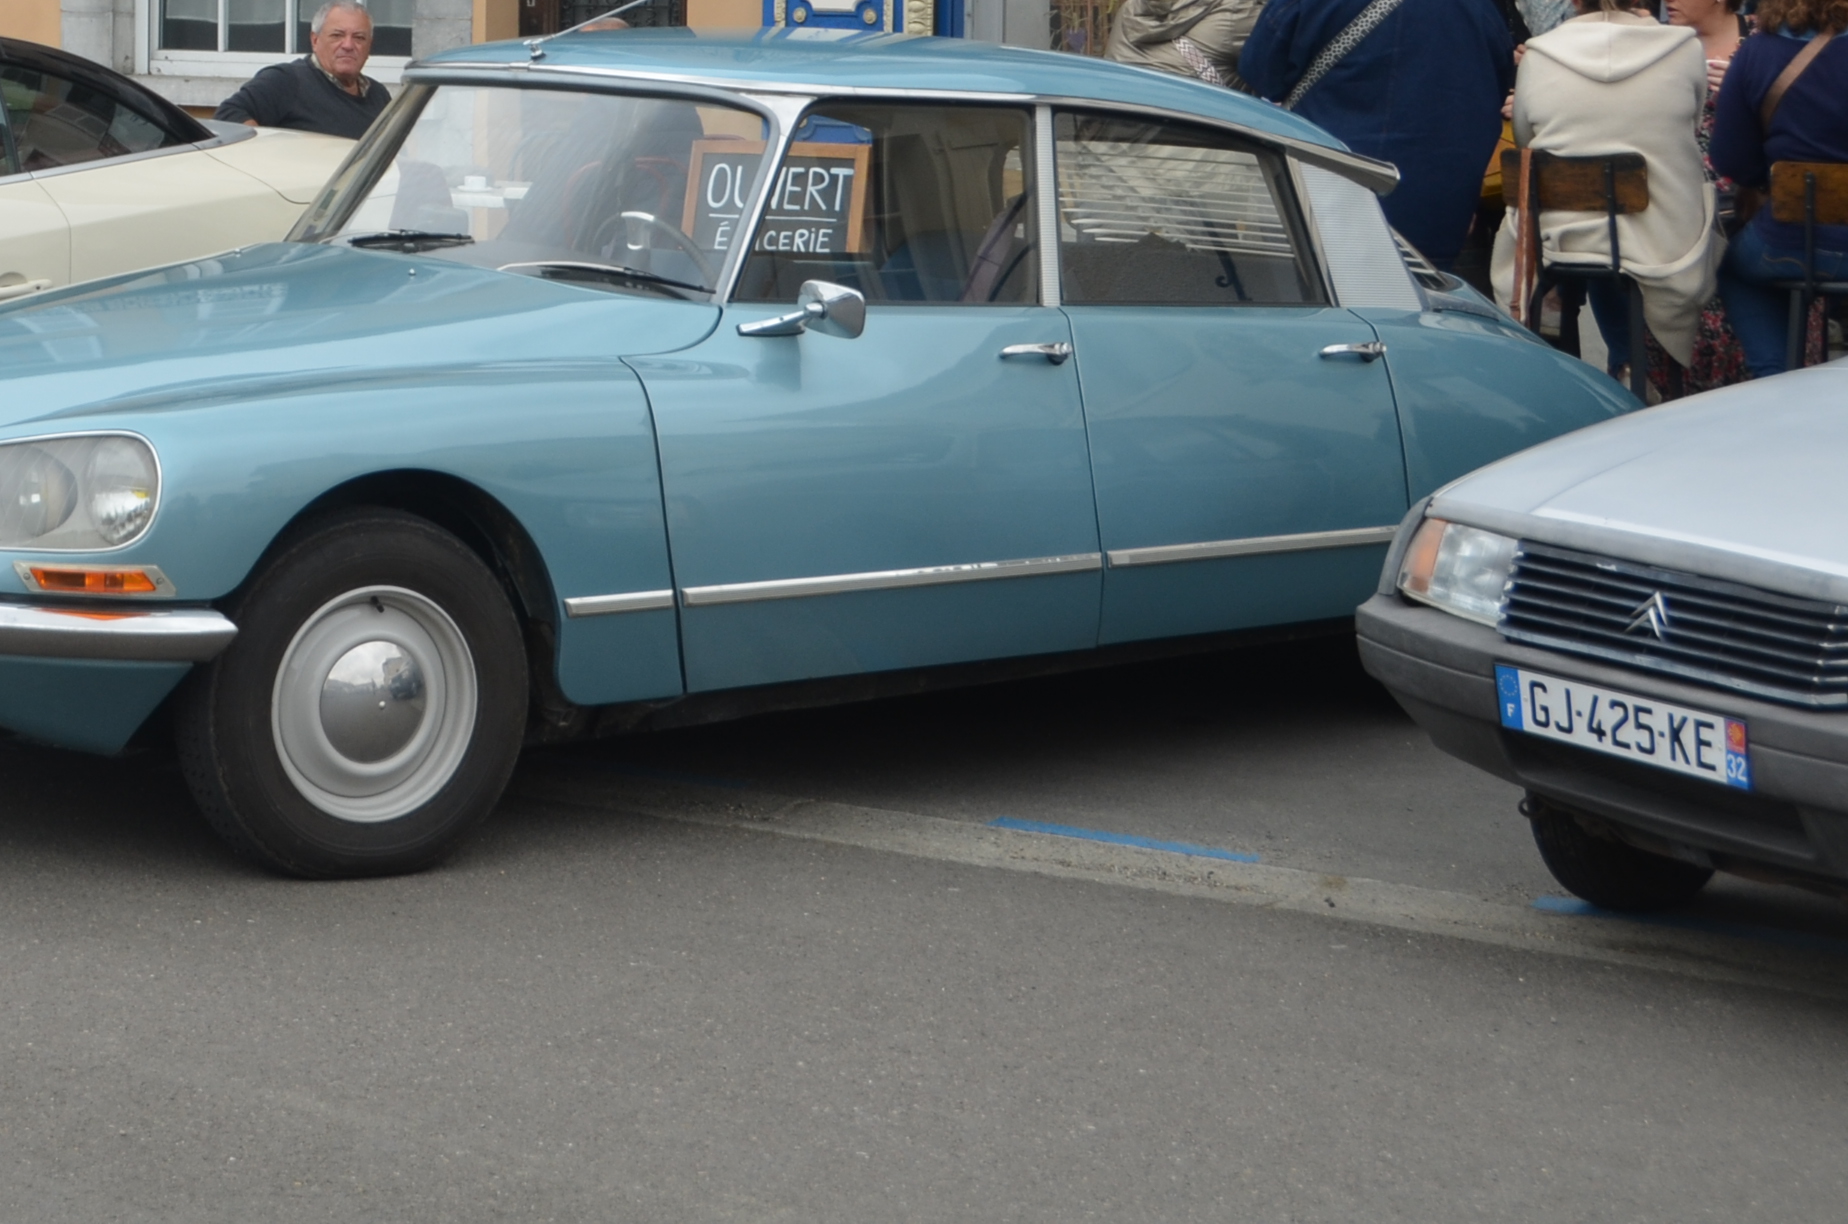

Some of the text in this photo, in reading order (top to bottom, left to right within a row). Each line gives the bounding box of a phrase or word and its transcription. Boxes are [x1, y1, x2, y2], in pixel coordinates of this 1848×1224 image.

[1506, 702, 1516, 718] F
[1528, 679, 1718, 772] GJ-425-KE
[1727, 753, 1748, 782] 32
